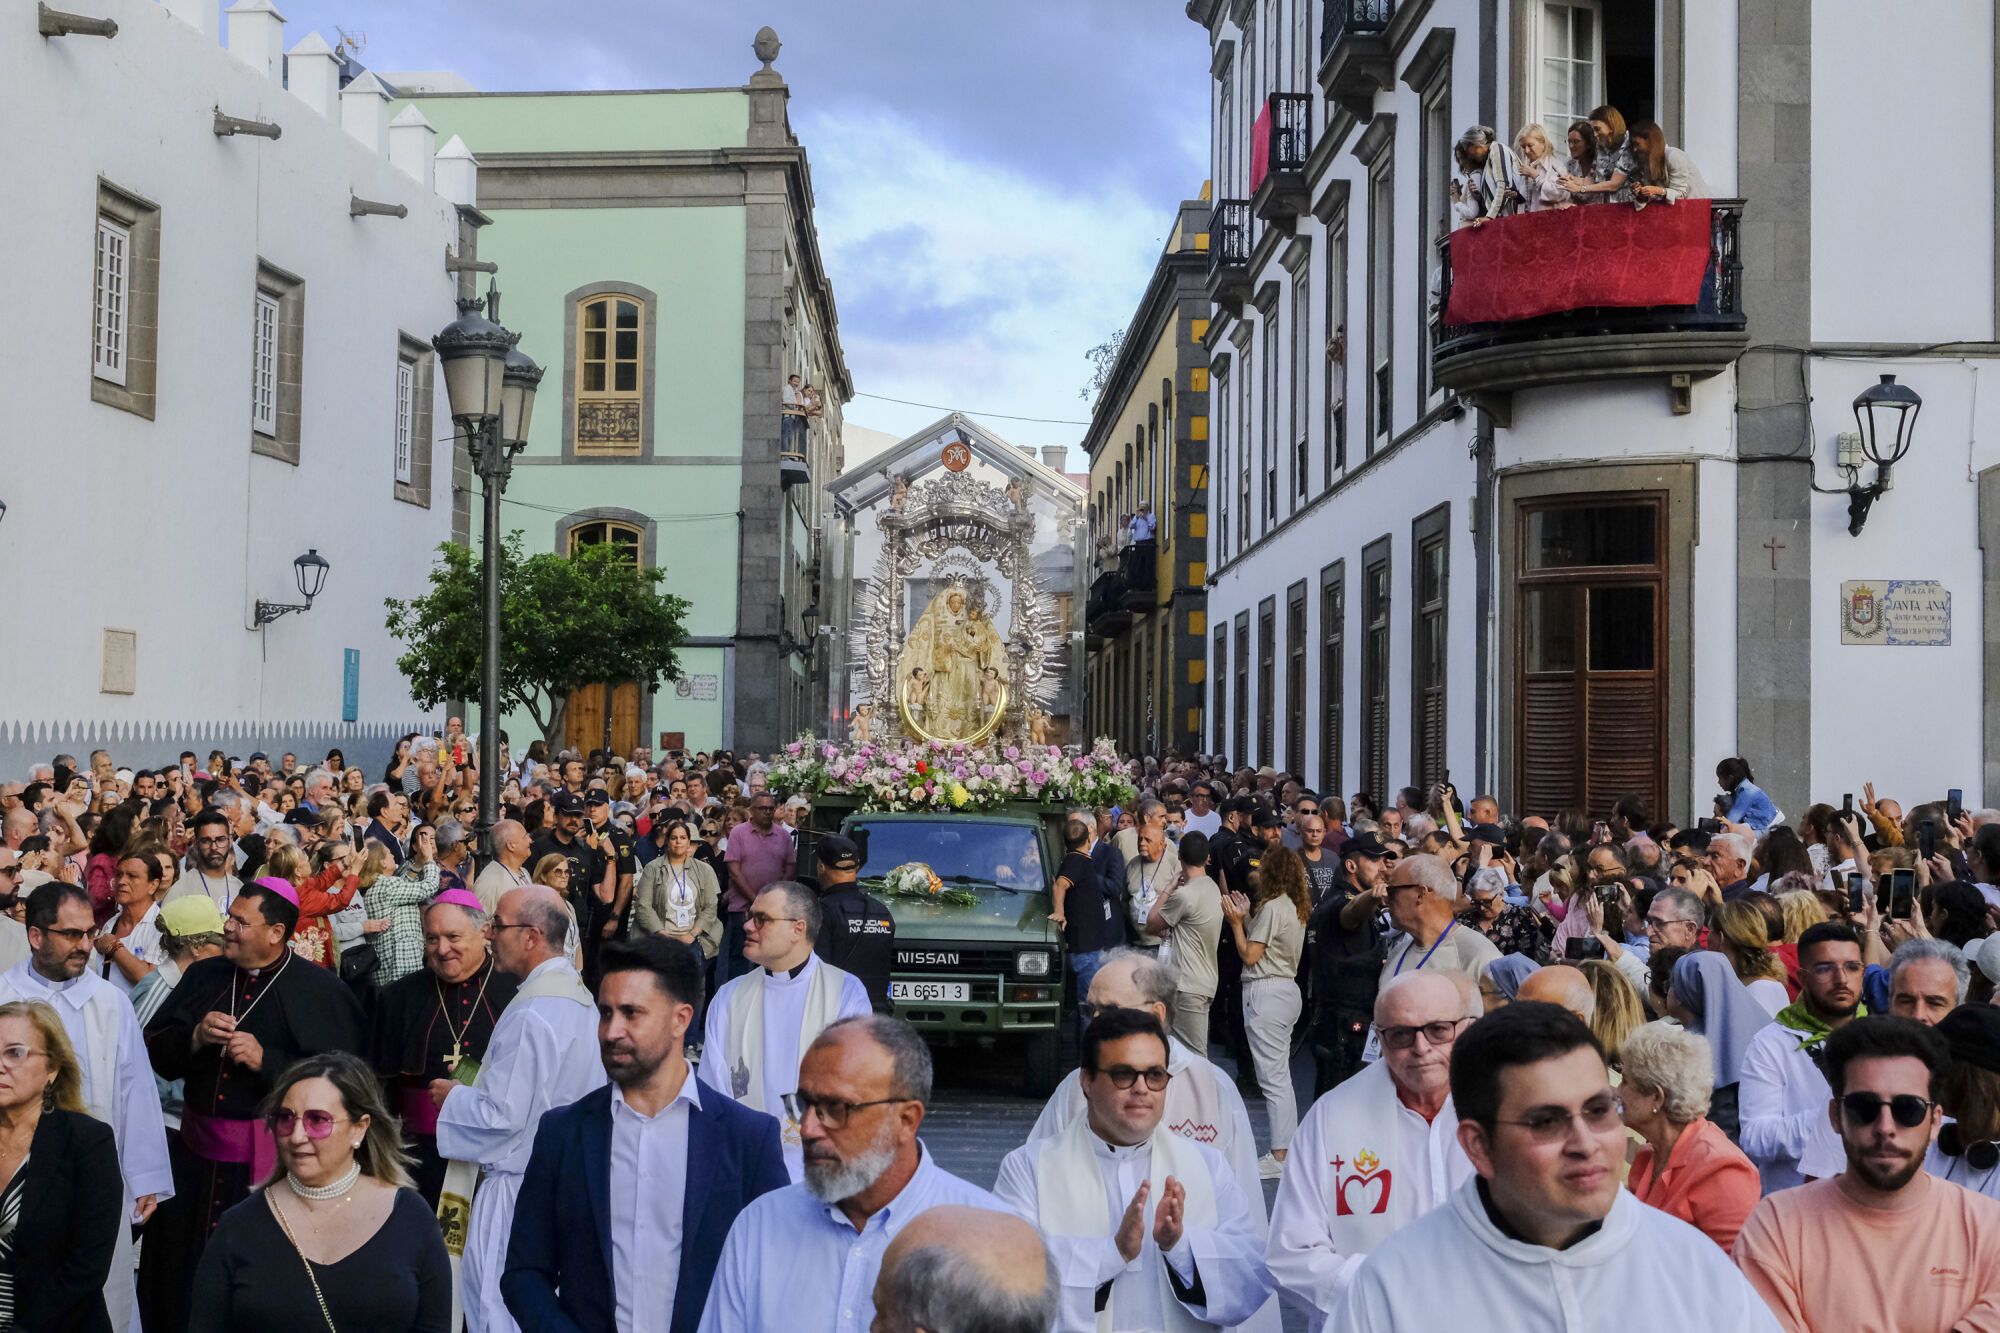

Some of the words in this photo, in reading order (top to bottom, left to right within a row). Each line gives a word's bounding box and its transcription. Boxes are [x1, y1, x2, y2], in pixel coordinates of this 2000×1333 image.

[1904, 586, 1926, 595] PLAZA
[1928, 587, 1936, 595] DE
[1892, 600, 1921, 612] SANTA
[1925, 600, 1947, 612] ANA
[897, 951, 960, 965] NISSAN
[892, 983, 909, 998] EA
[914, 984, 945, 998] 6651
[954, 985, 962, 999] 3
